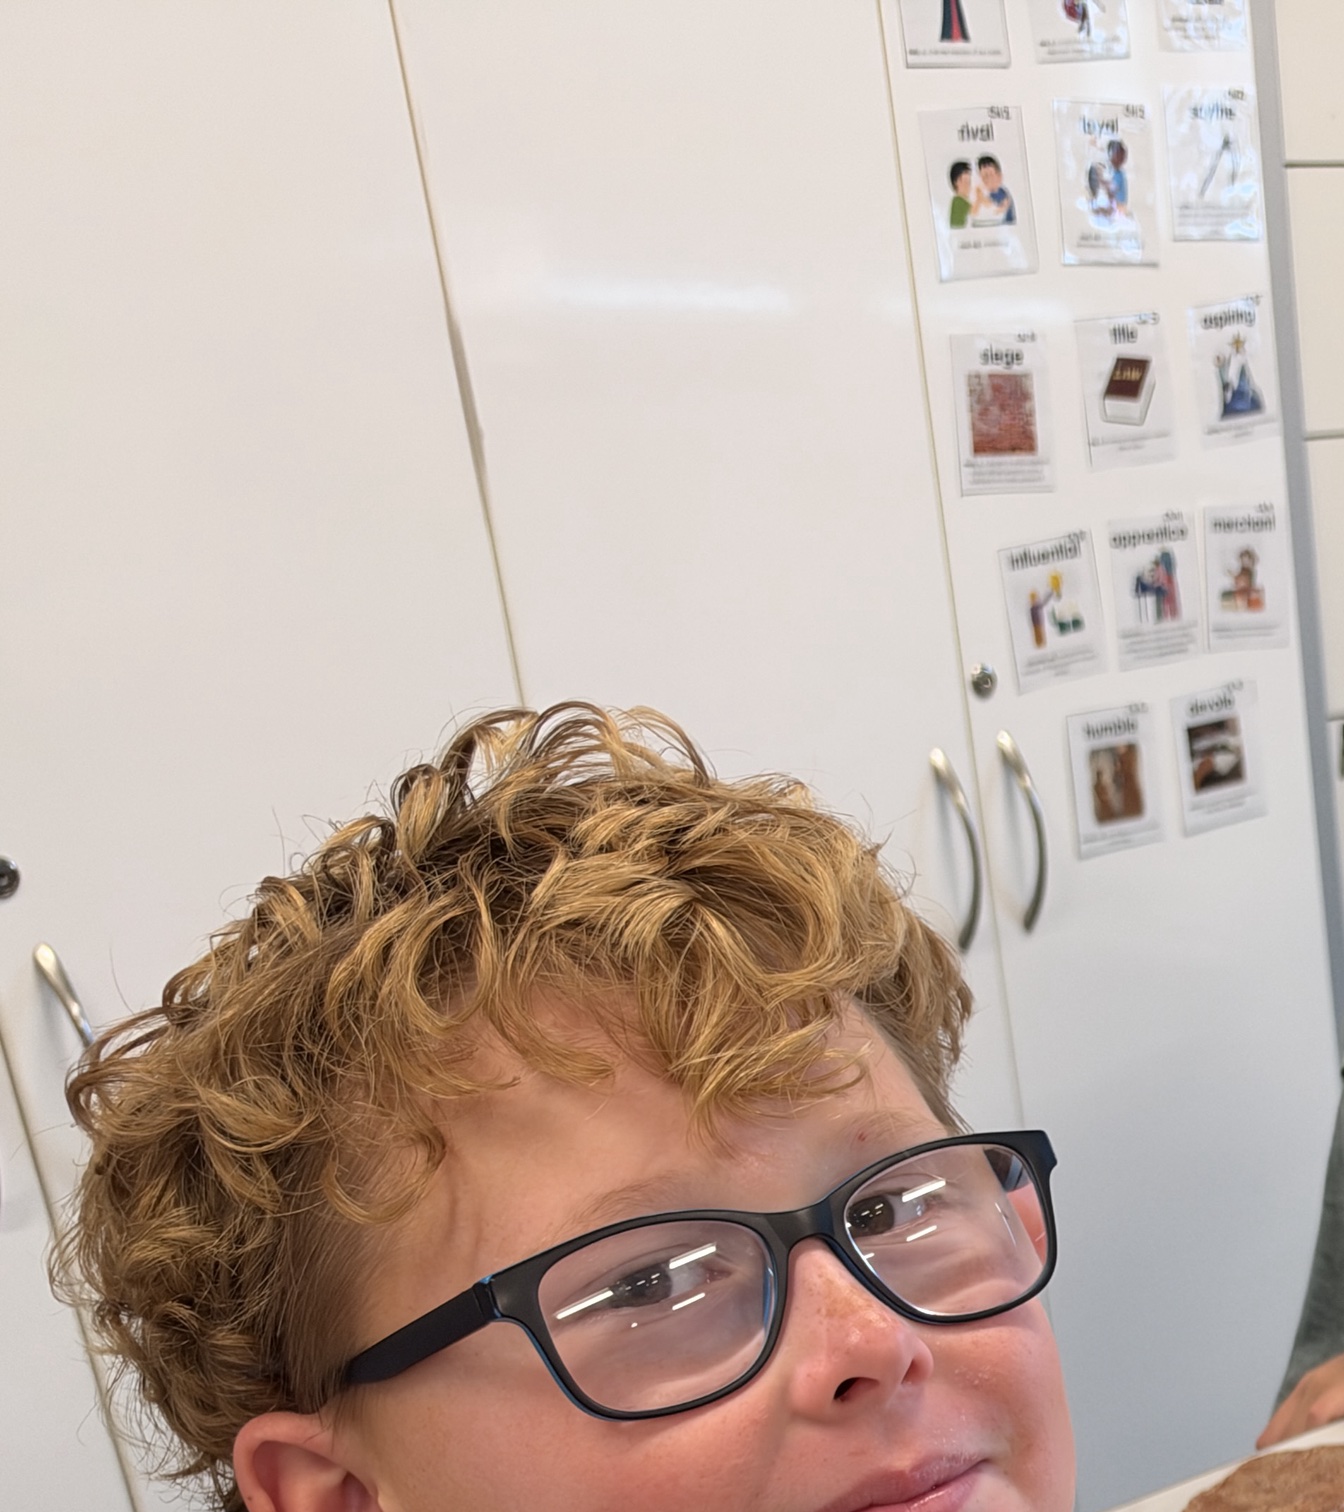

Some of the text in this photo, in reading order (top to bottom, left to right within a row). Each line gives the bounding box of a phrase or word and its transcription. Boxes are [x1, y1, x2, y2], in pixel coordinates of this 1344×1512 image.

[957, 120, 995, 142] rival
[979, 346, 1025, 369] siege
[1109, 525, 1189, 549] apprentice
[1009, 541, 1082, 571] influential
[1084, 716, 1139, 739] humble
